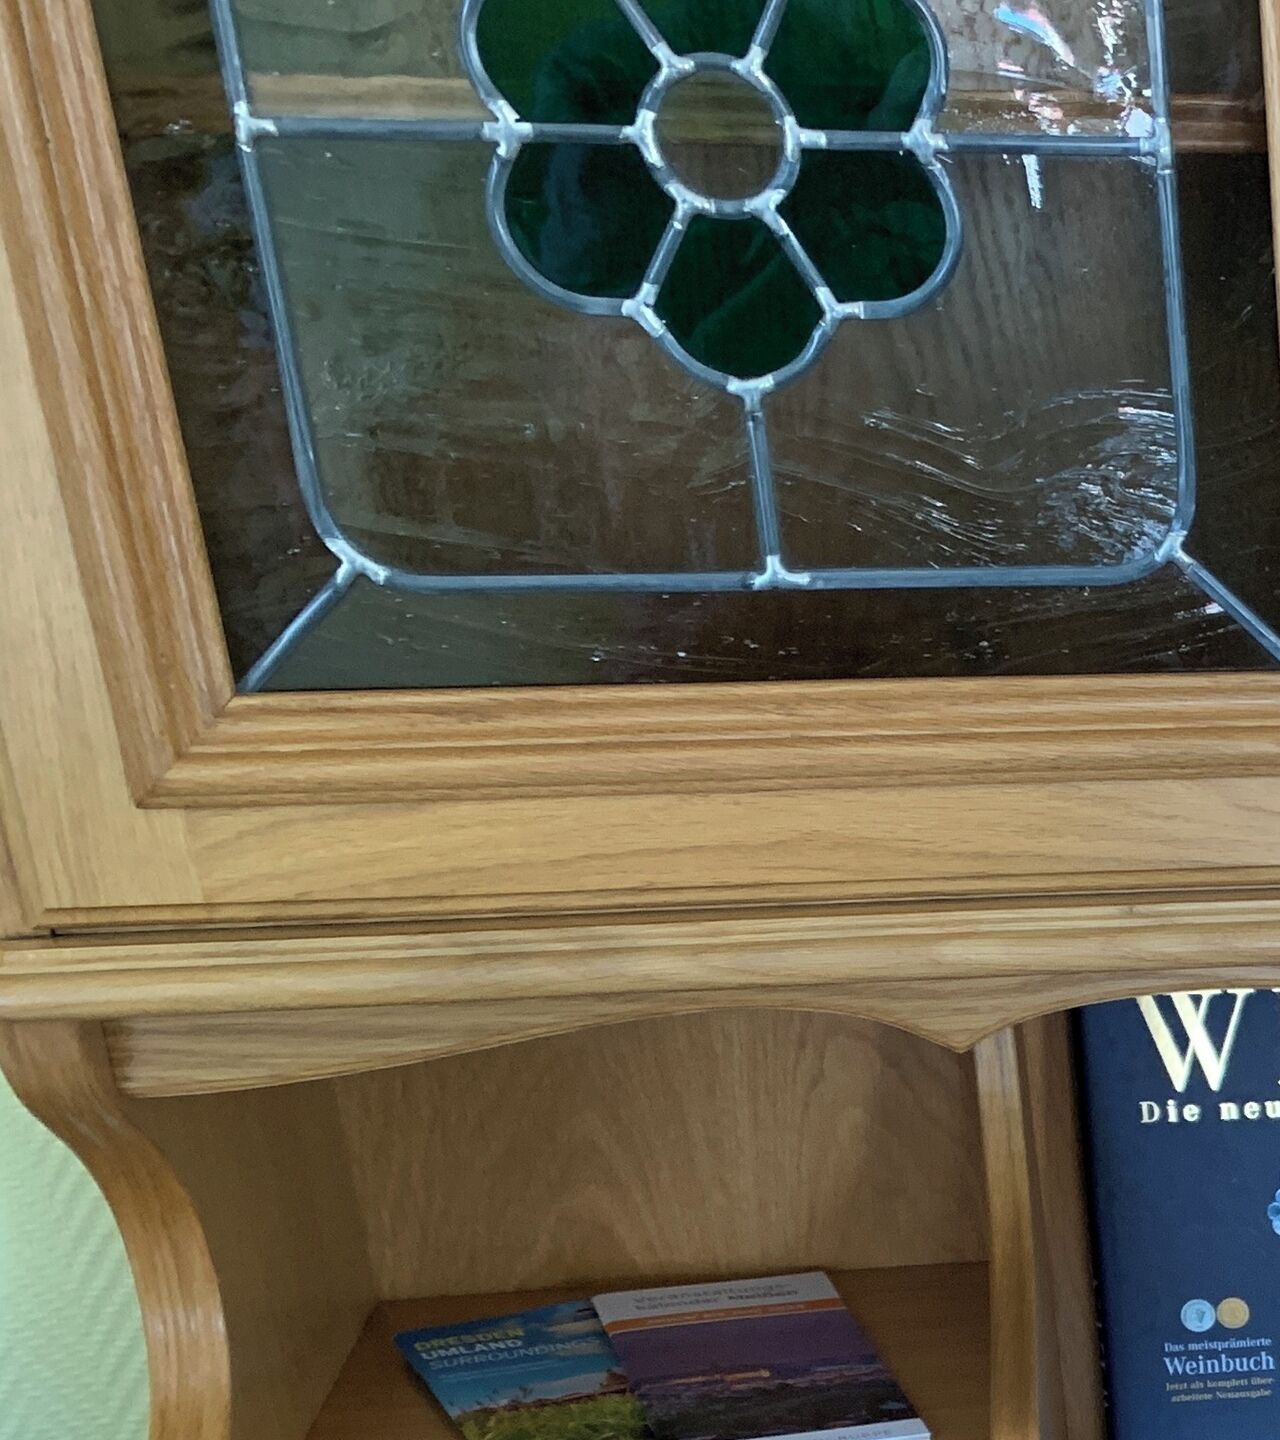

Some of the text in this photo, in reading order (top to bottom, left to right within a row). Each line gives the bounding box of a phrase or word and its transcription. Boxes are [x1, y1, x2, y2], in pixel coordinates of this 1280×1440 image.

[1140, 1099, 1200, 1124] Die
[420, 1338, 523, 1361] UMLAND
[1164, 1337, 1273, 1352] Das meistprämierte
[1163, 1351, 1276, 1376] Weinbuch
